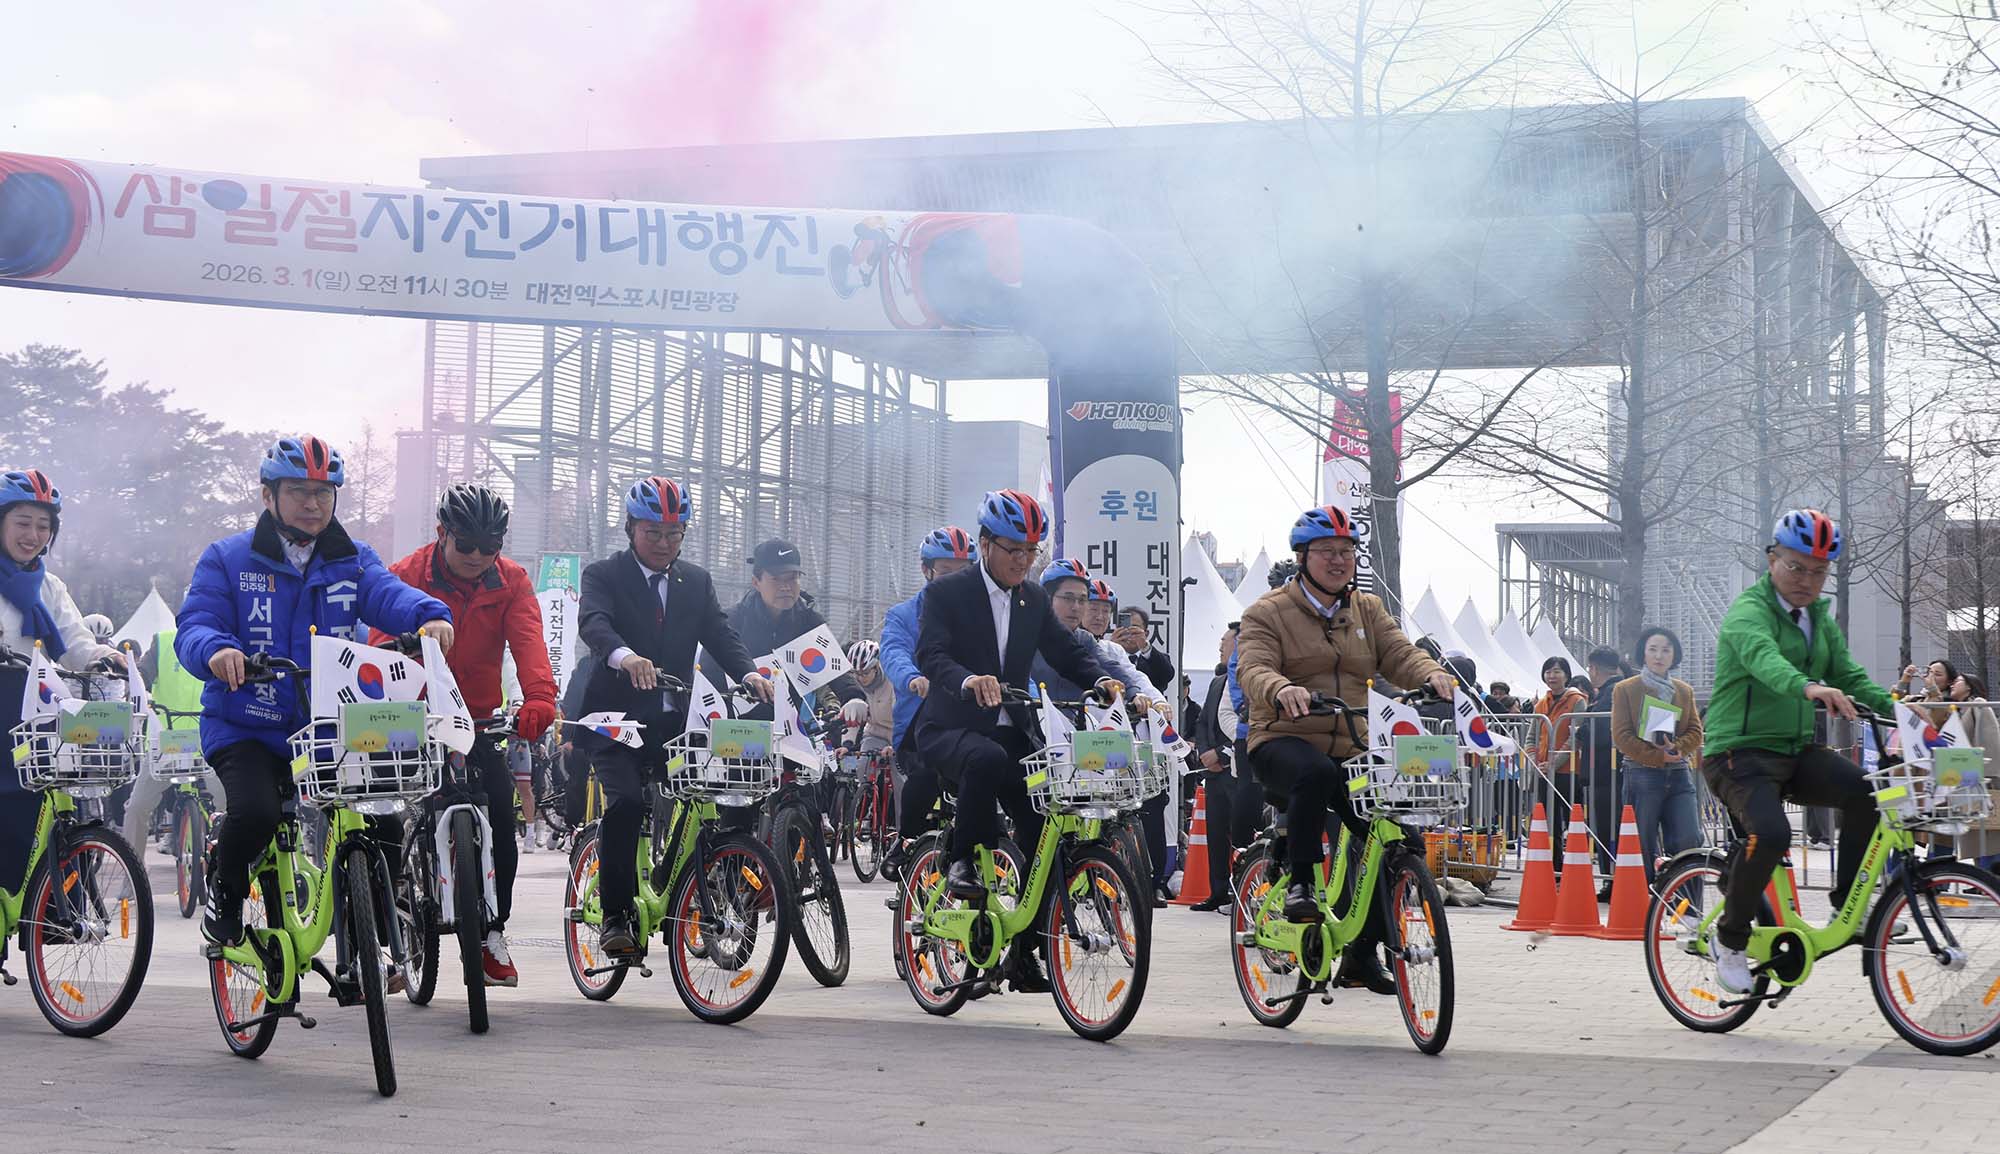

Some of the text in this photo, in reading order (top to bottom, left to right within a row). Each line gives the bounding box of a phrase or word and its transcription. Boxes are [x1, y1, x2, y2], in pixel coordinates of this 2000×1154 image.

[114, 173, 359, 253] 삼일절
[355, 274, 397, 295] 오전
[403, 275, 448, 297] 11시
[453, 278, 508, 301] 30분
[525, 282, 739, 312] 대전엑스포시민광장
[1099, 490, 1158, 521] 후원
[239, 581, 266, 592] 민주당
[267, 574, 276, 593] 1
[1146, 541, 1170, 654] 대전지
[248, 597, 278, 705] 서구장
